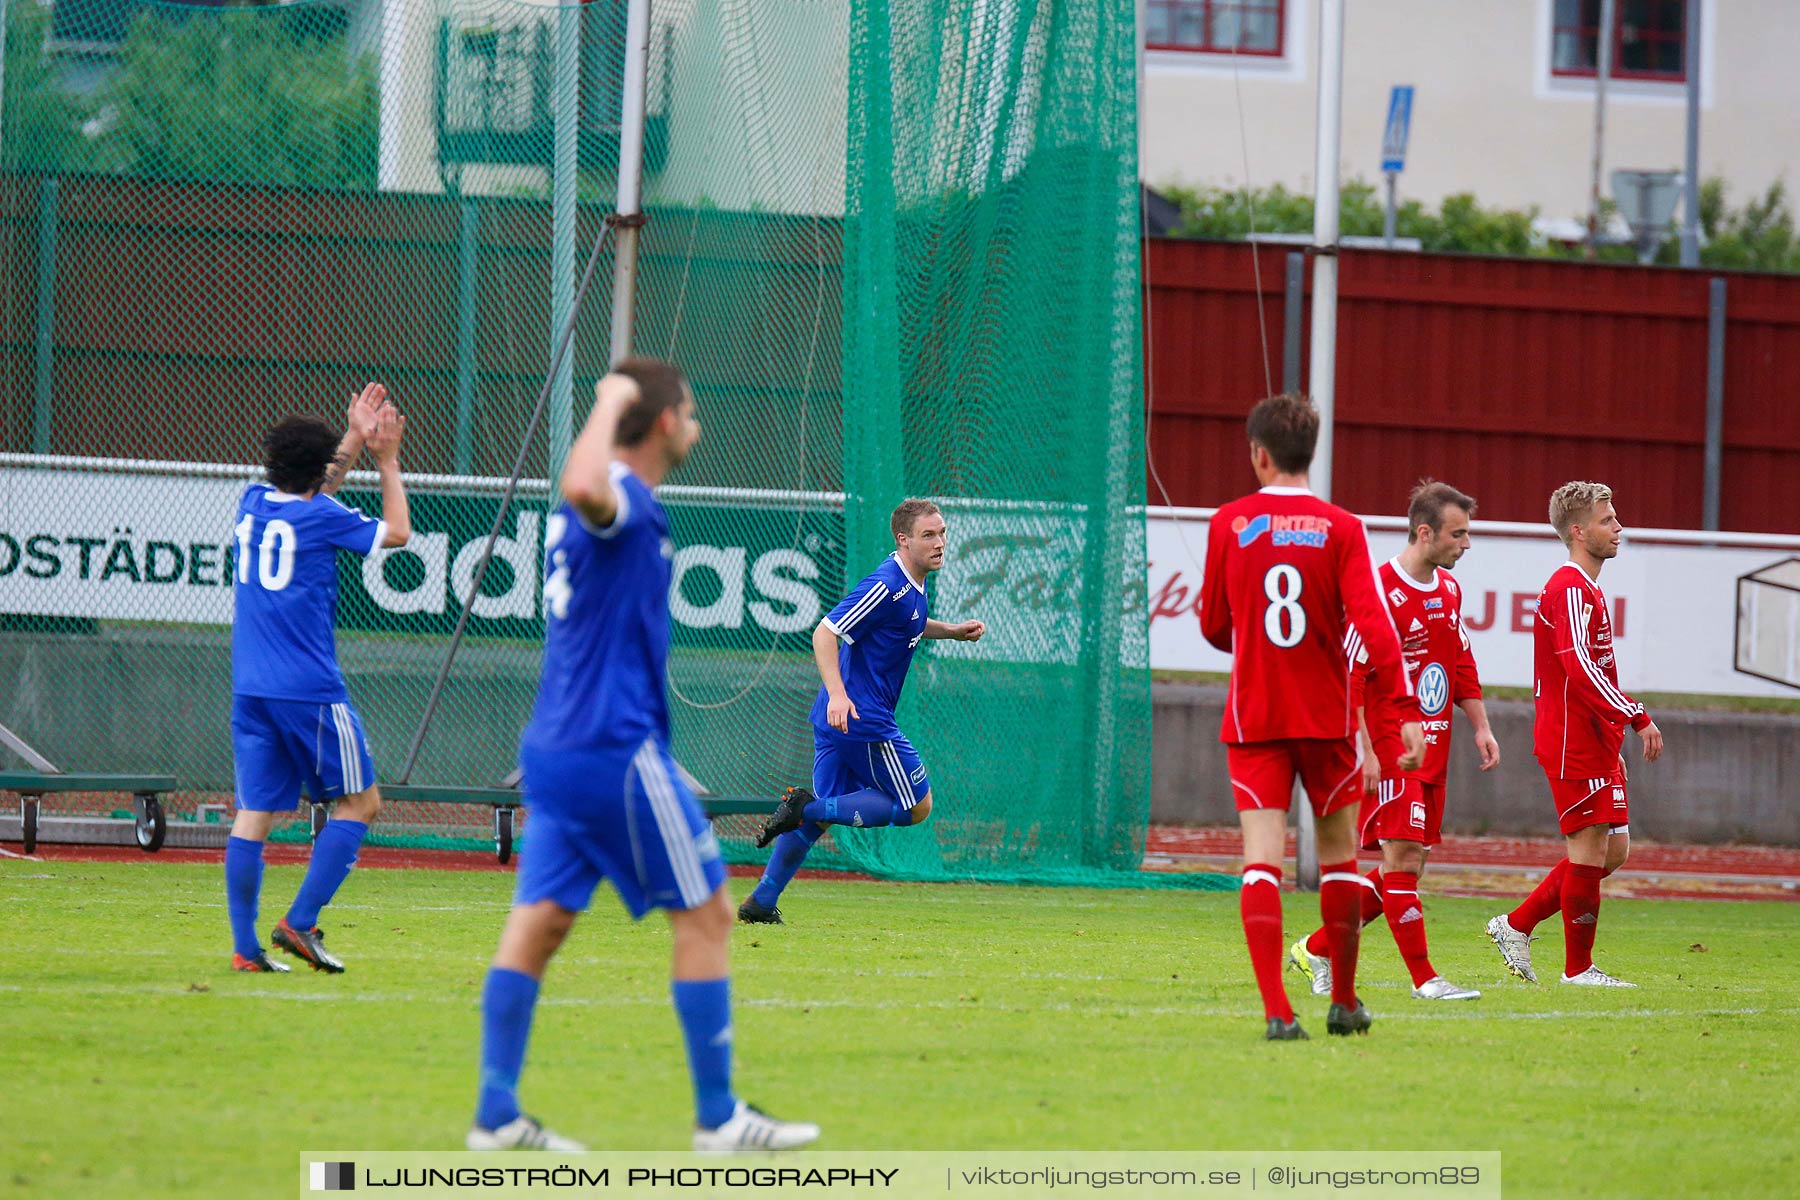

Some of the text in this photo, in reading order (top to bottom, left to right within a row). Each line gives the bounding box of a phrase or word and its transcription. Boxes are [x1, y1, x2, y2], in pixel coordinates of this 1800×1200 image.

[235, 514, 295, 591] 10
[362, 510, 821, 633] adas
[1272, 530, 1328, 548] SPORT
[1264, 563, 1307, 648] 8
[1463, 591, 1626, 638] JEI
